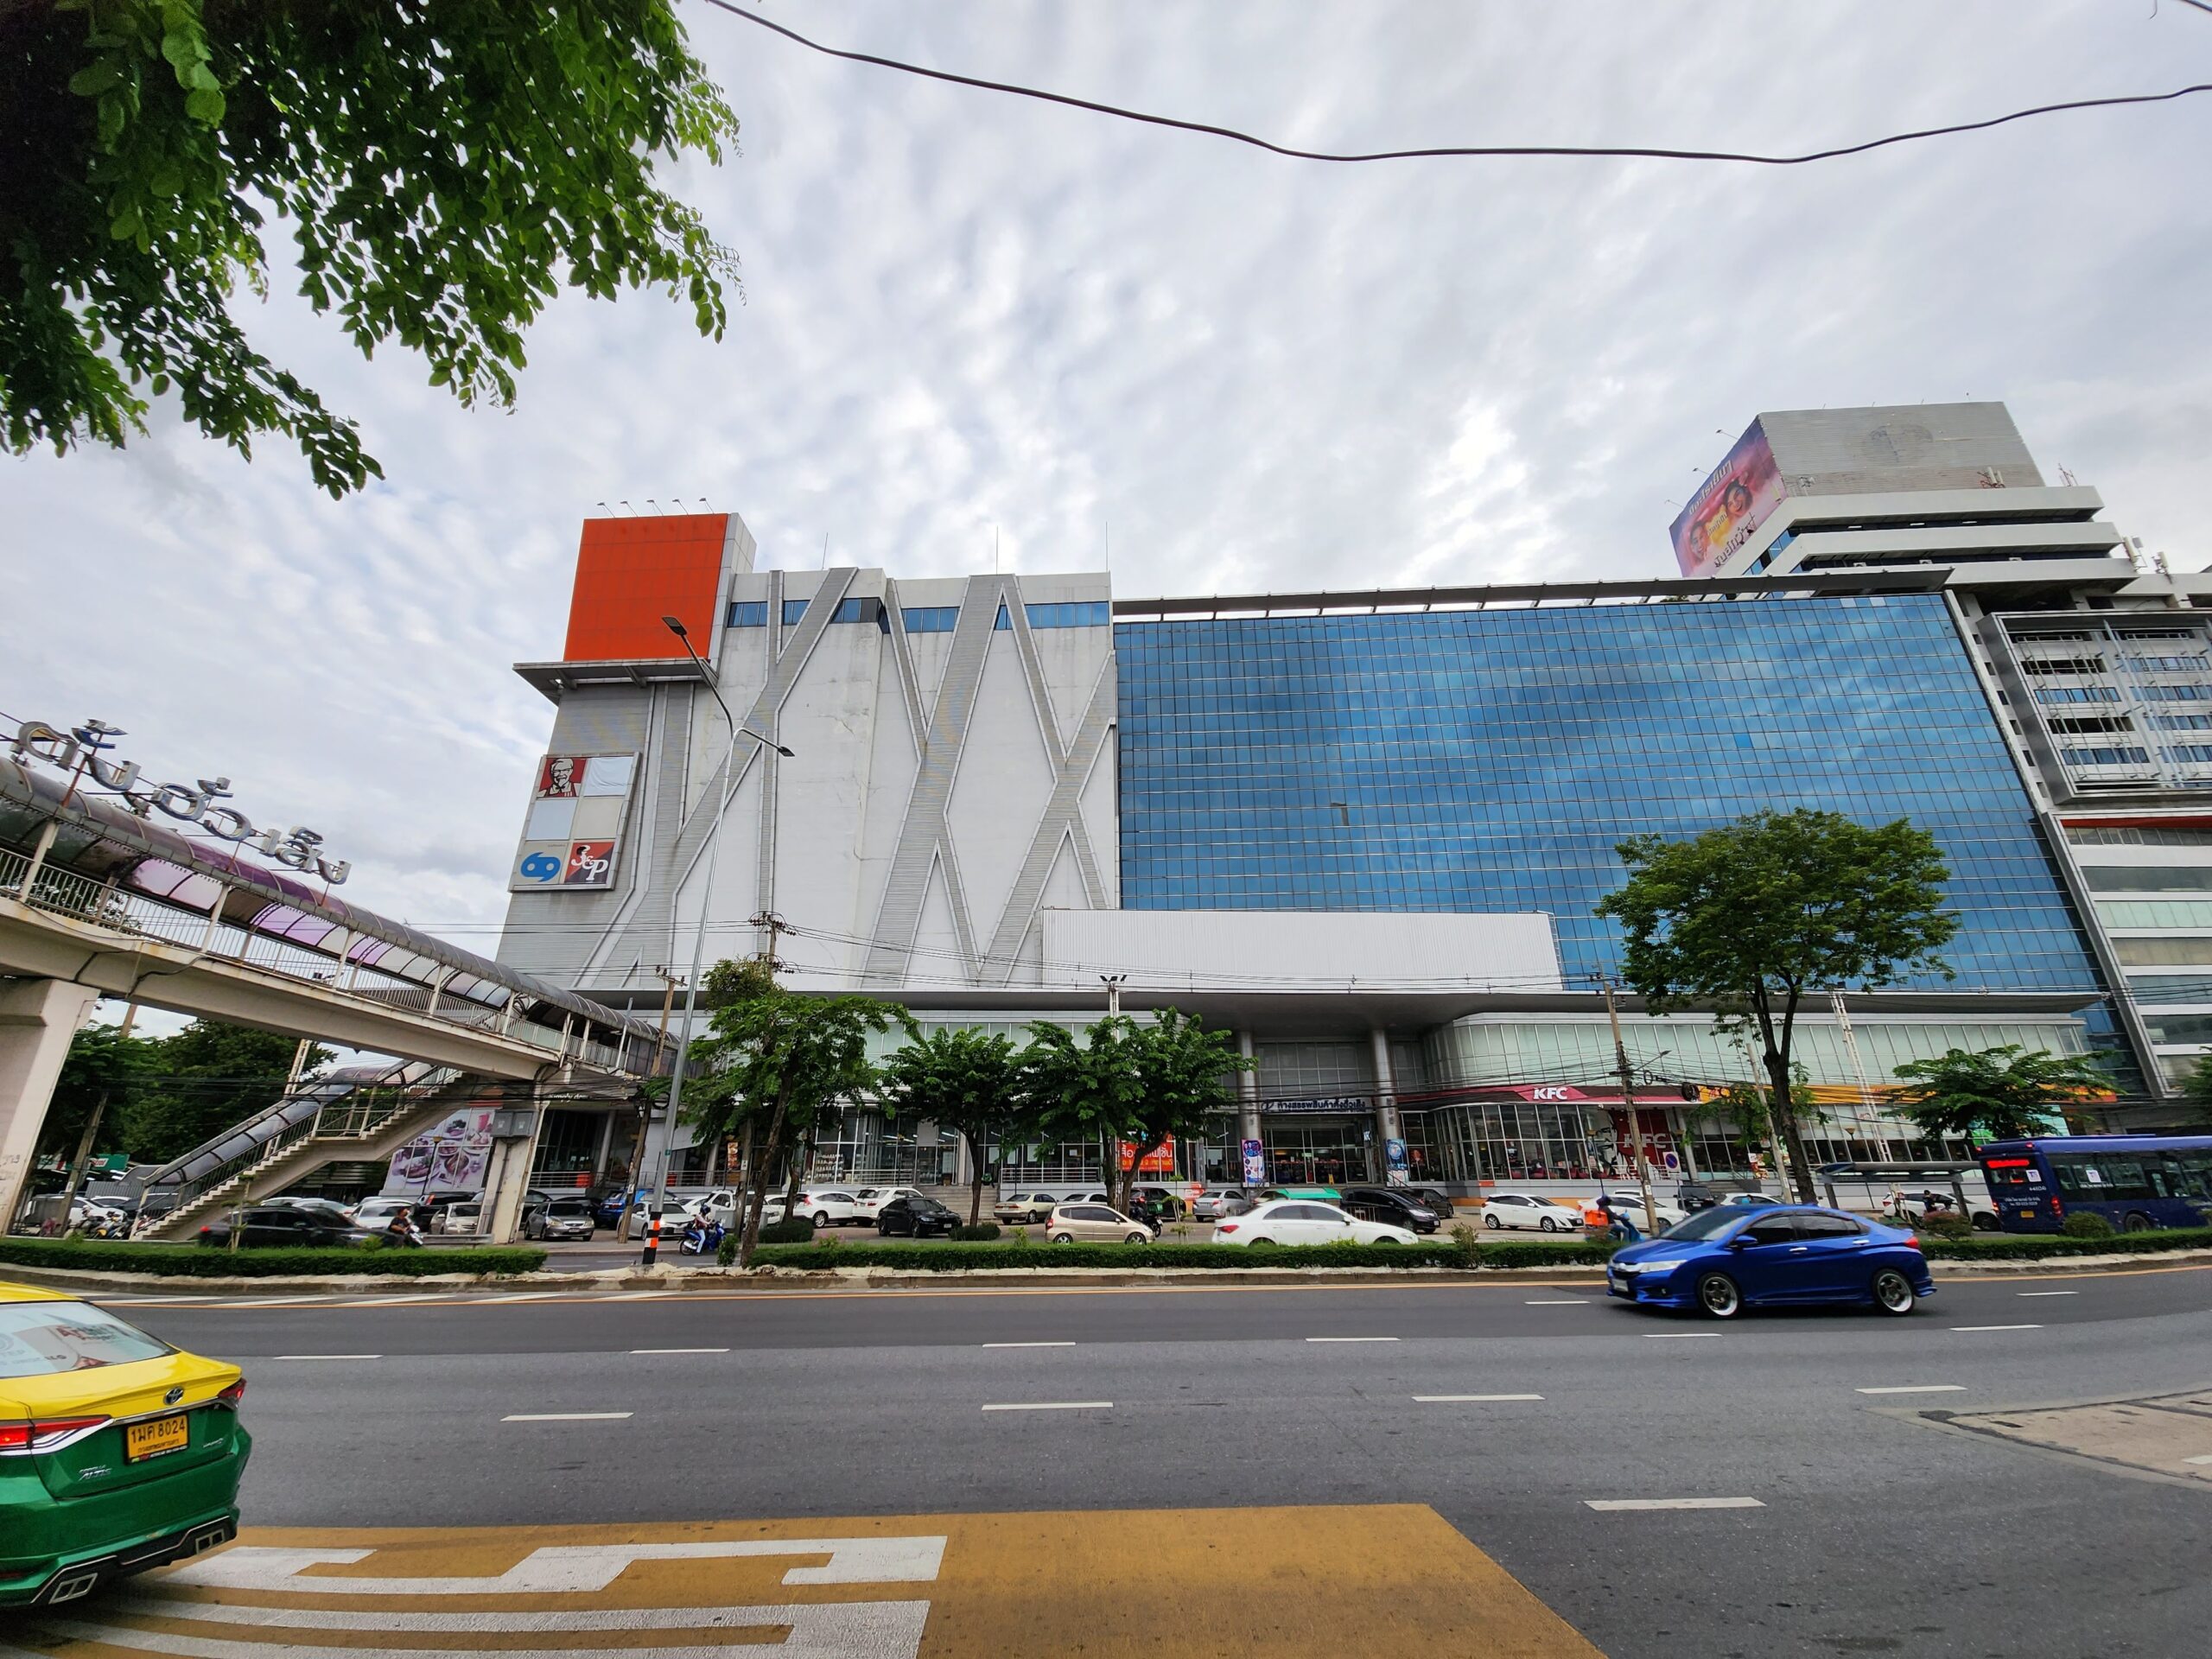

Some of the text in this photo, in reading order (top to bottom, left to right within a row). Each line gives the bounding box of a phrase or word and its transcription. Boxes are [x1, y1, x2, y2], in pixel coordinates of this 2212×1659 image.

[1533, 1087, 1568, 1100] KFC
[1623, 1133, 1667, 1148] KFC
[158, 1418, 185, 1437] 8024
